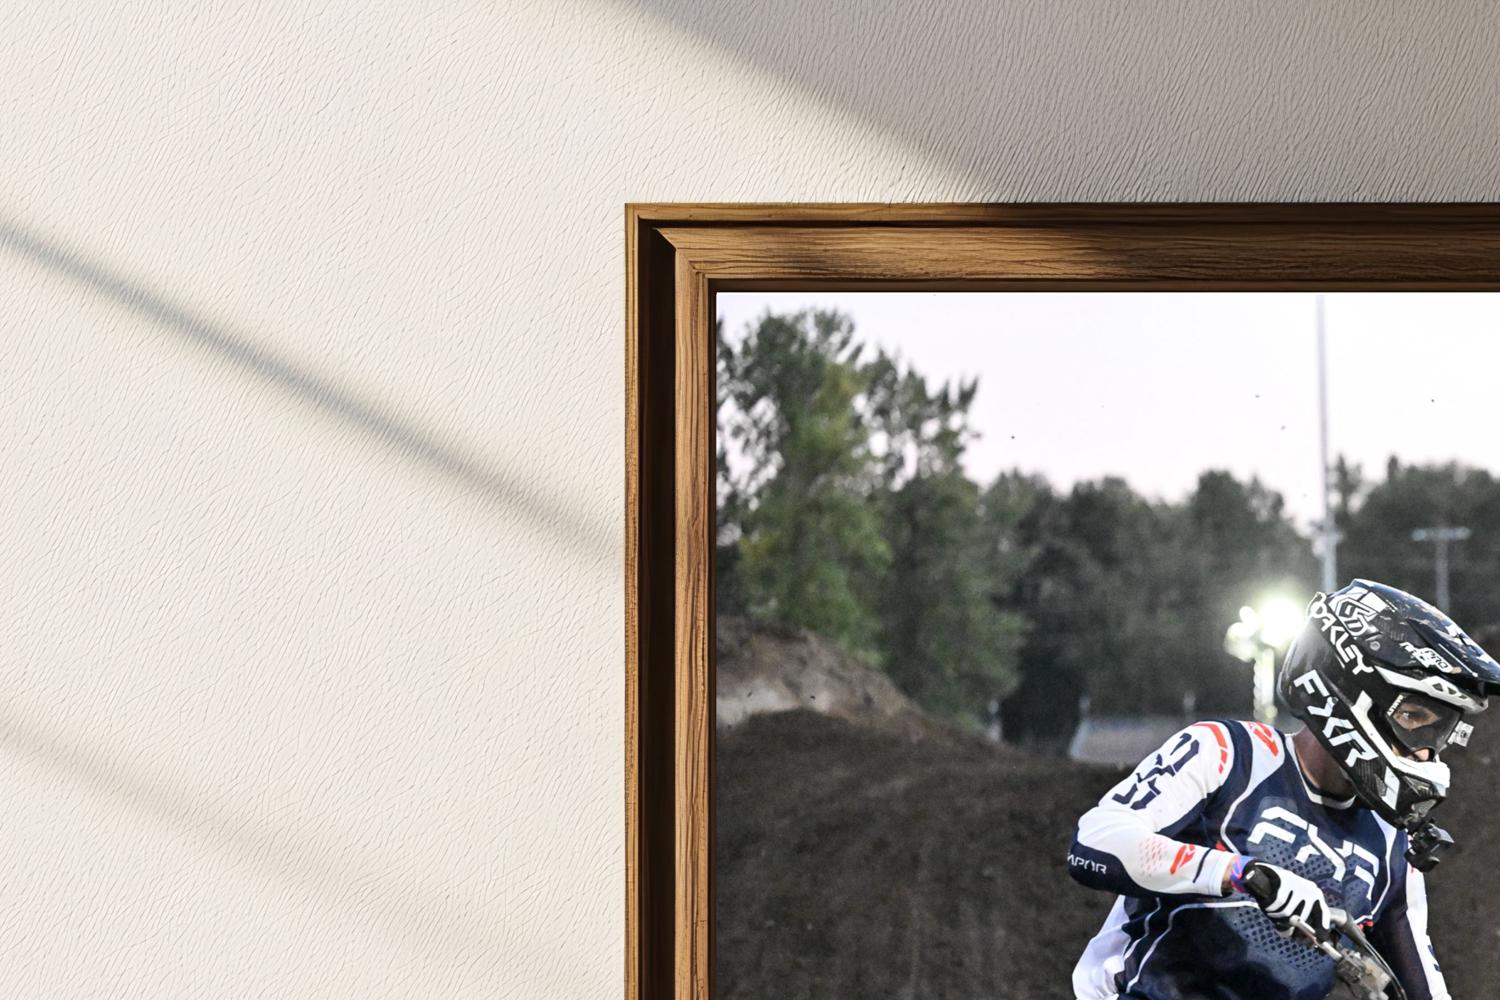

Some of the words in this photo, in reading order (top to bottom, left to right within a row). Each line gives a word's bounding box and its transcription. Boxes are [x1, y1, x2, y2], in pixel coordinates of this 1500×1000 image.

[1306, 591, 1375, 676] OAKLEY
[1293, 669, 1379, 768] FXR
[1246, 805, 1381, 901] FXR
